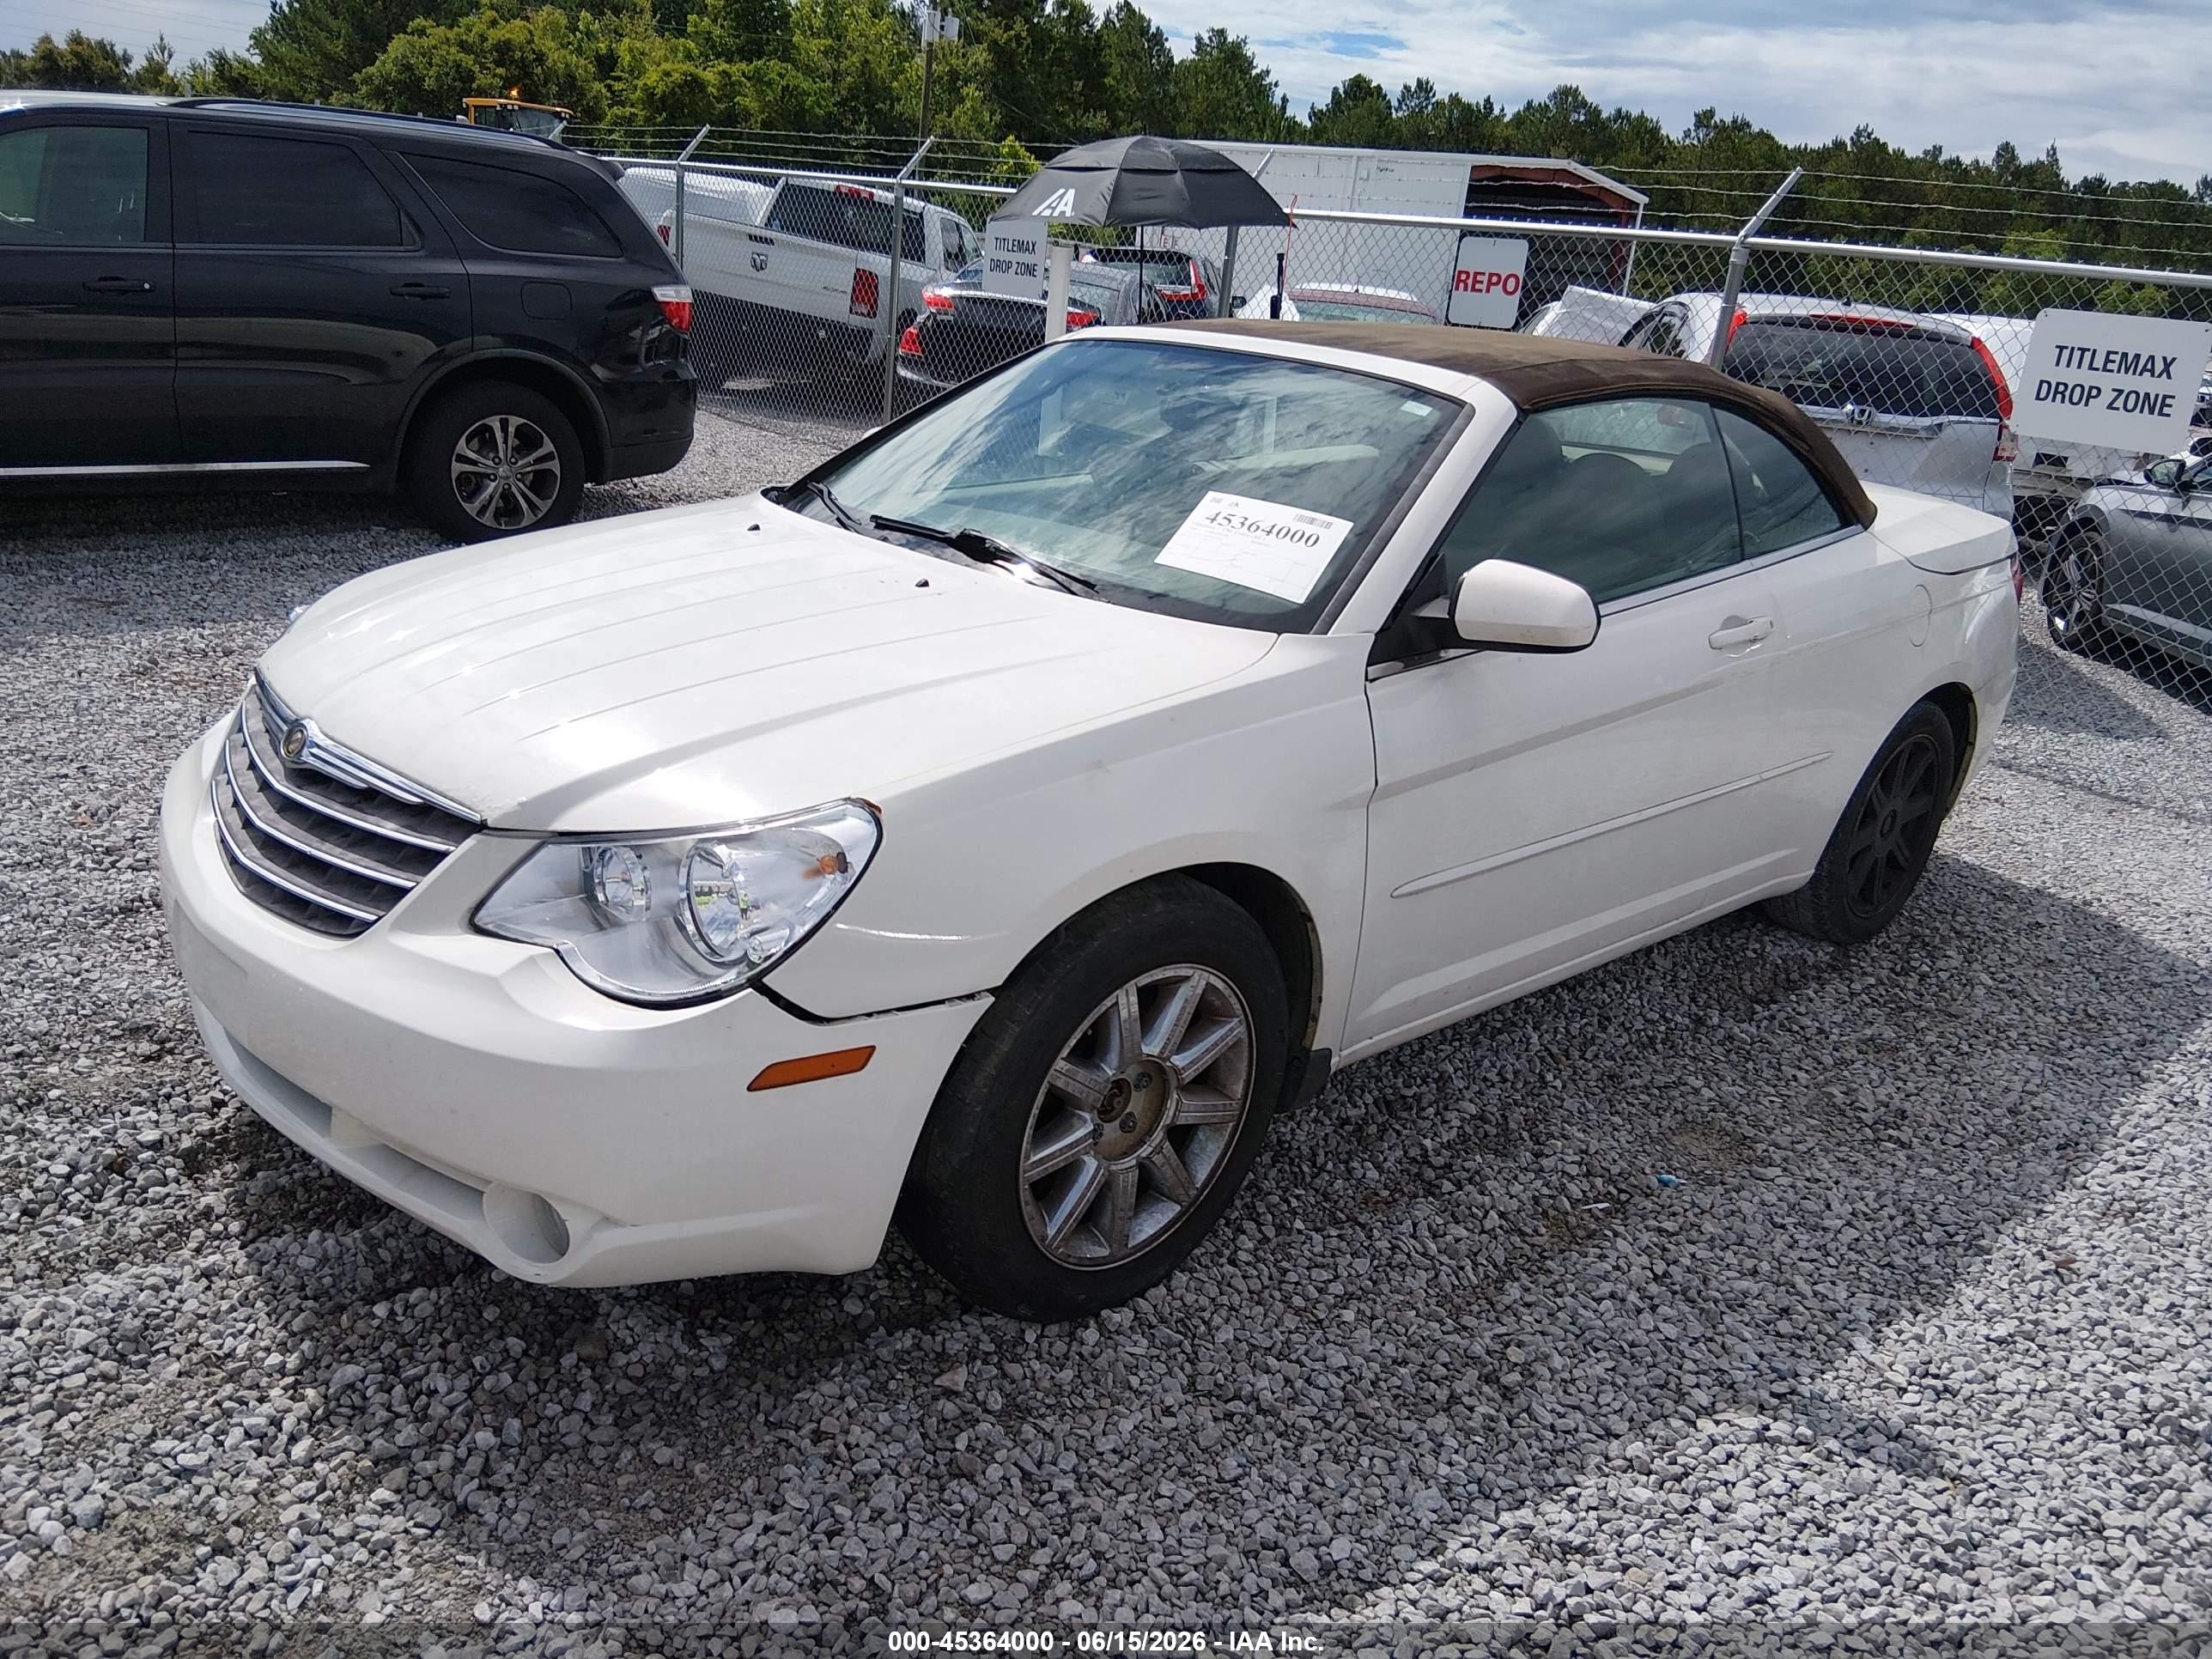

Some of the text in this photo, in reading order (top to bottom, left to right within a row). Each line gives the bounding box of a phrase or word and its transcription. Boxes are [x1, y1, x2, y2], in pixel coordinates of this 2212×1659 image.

[994, 237, 1037, 255] TITLEMAX
[989, 258, 1038, 278] DROP ZONE
[1454, 270, 1521, 296] REPO
[2054, 344, 2178, 380] TITLEMAX
[2034, 379, 2177, 418] DROP ZONE
[1204, 511, 1321, 548] 45364000
